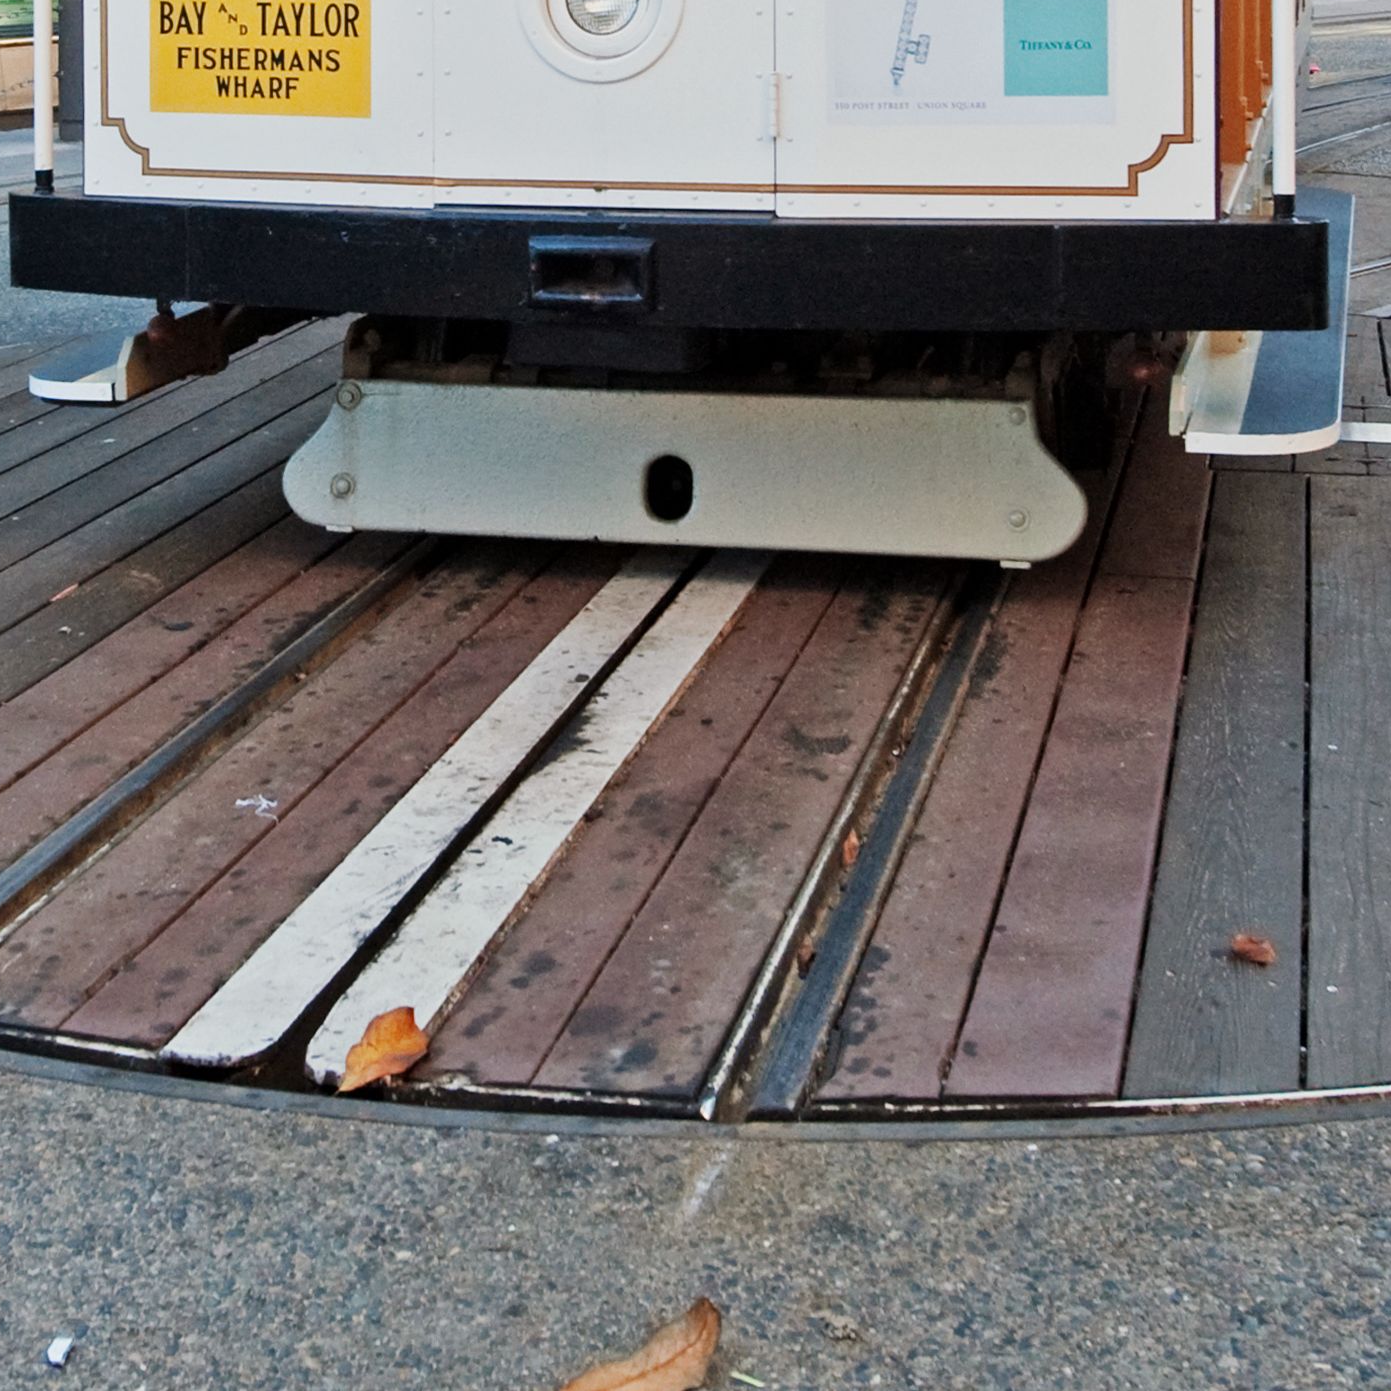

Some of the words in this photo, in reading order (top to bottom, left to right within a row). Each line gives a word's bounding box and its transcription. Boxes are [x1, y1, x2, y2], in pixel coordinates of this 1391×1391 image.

[159, 1, 206, 36] BAY
[218, 3, 248, 36] AND
[257, 2, 360, 37] TAYLOR
[177, 46, 341, 72] FISHERMANS
[215, 75, 300, 99] WHARF
[877, 101, 910, 110] STREET
